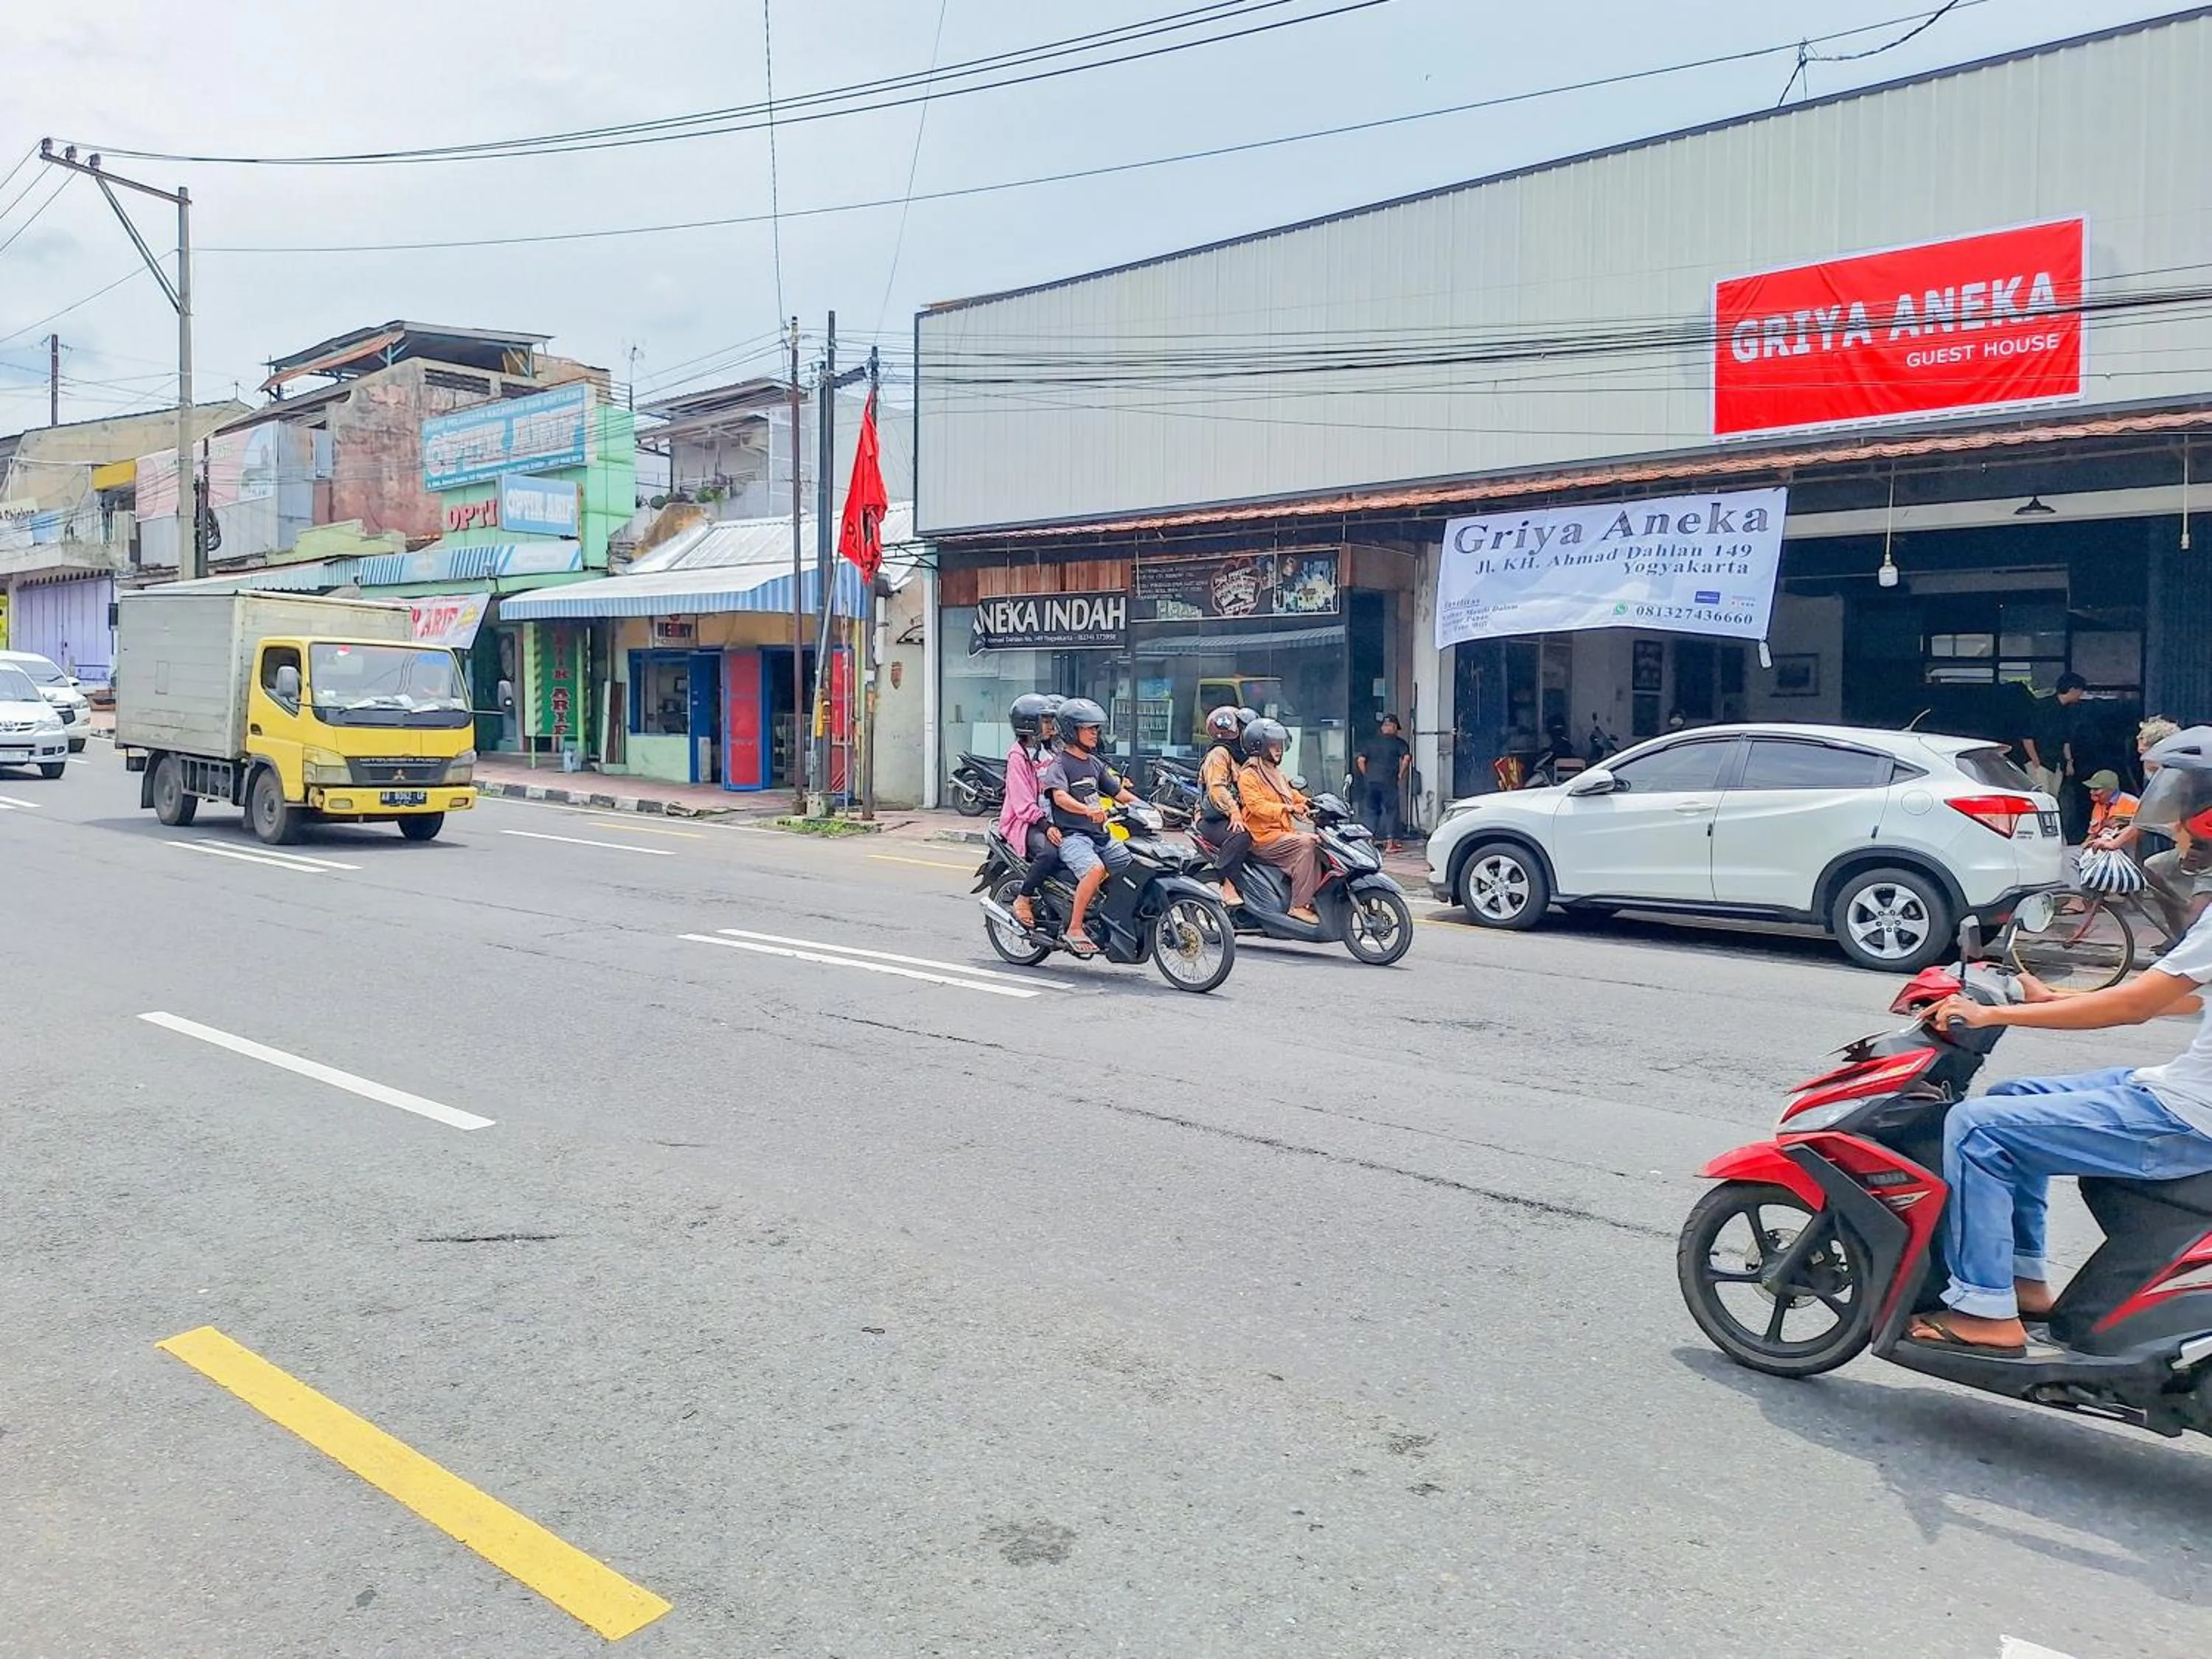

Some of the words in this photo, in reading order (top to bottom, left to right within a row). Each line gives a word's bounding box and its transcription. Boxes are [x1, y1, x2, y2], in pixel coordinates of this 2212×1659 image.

[1731, 301, 1872, 363] GRIYA
[1889, 271, 2062, 342] ANEKA
[1906, 344, 1975, 367] GUEST
[1983, 333, 2060, 358] HOUSE
[1453, 521, 1583, 555] Griya
[1601, 502, 1770, 540] Aneka
[1503, 557, 1539, 571] KH.
[1548, 548, 1618, 567] Ahmad
[1627, 543, 1703, 560] Dahlan
[1716, 543, 1753, 558] 149
[1624, 560, 1748, 576] Yogyakarta
[1043, 597, 1127, 633] INDAH
[1636, 605, 1753, 625] 081327436660
